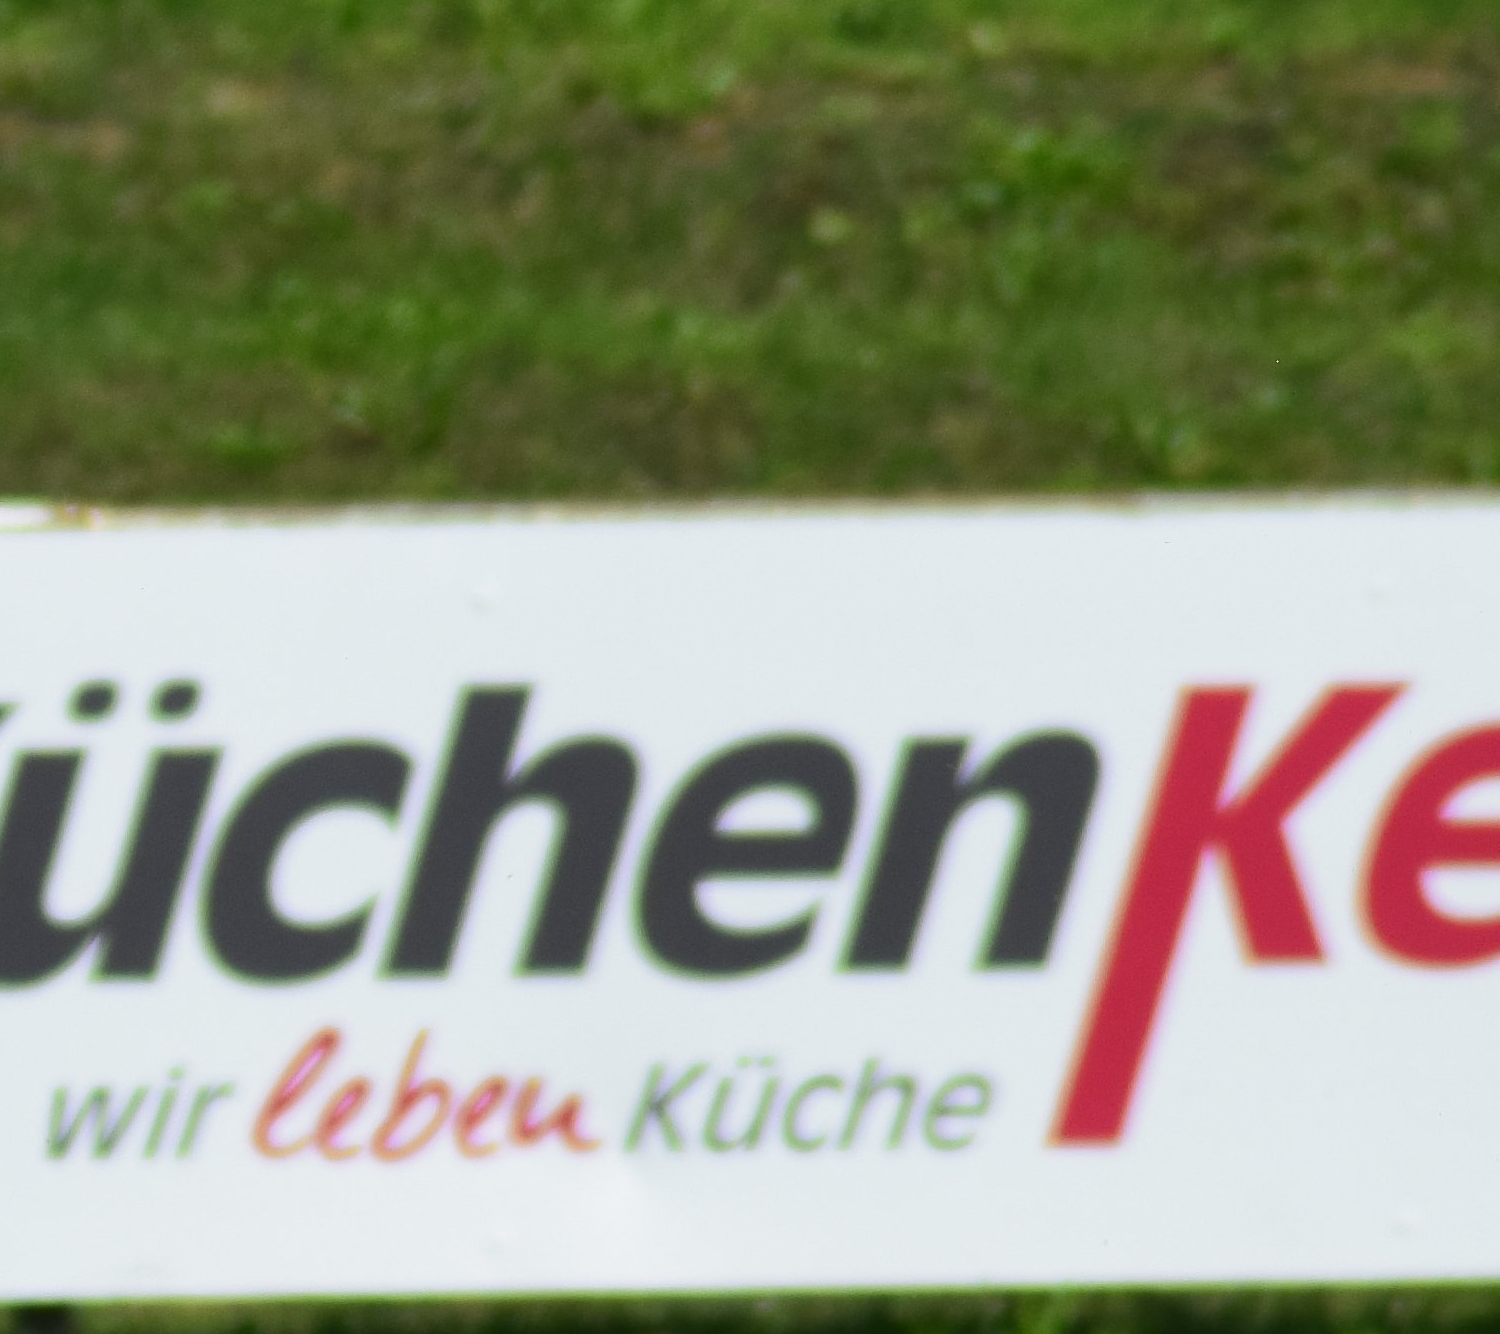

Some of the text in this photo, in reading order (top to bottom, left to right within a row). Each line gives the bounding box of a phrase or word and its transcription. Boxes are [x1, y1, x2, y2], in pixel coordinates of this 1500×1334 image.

[44, 1067, 236, 1163] wir
[250, 1025, 602, 1163] leben
[621, 1055, 996, 1155] Küche
